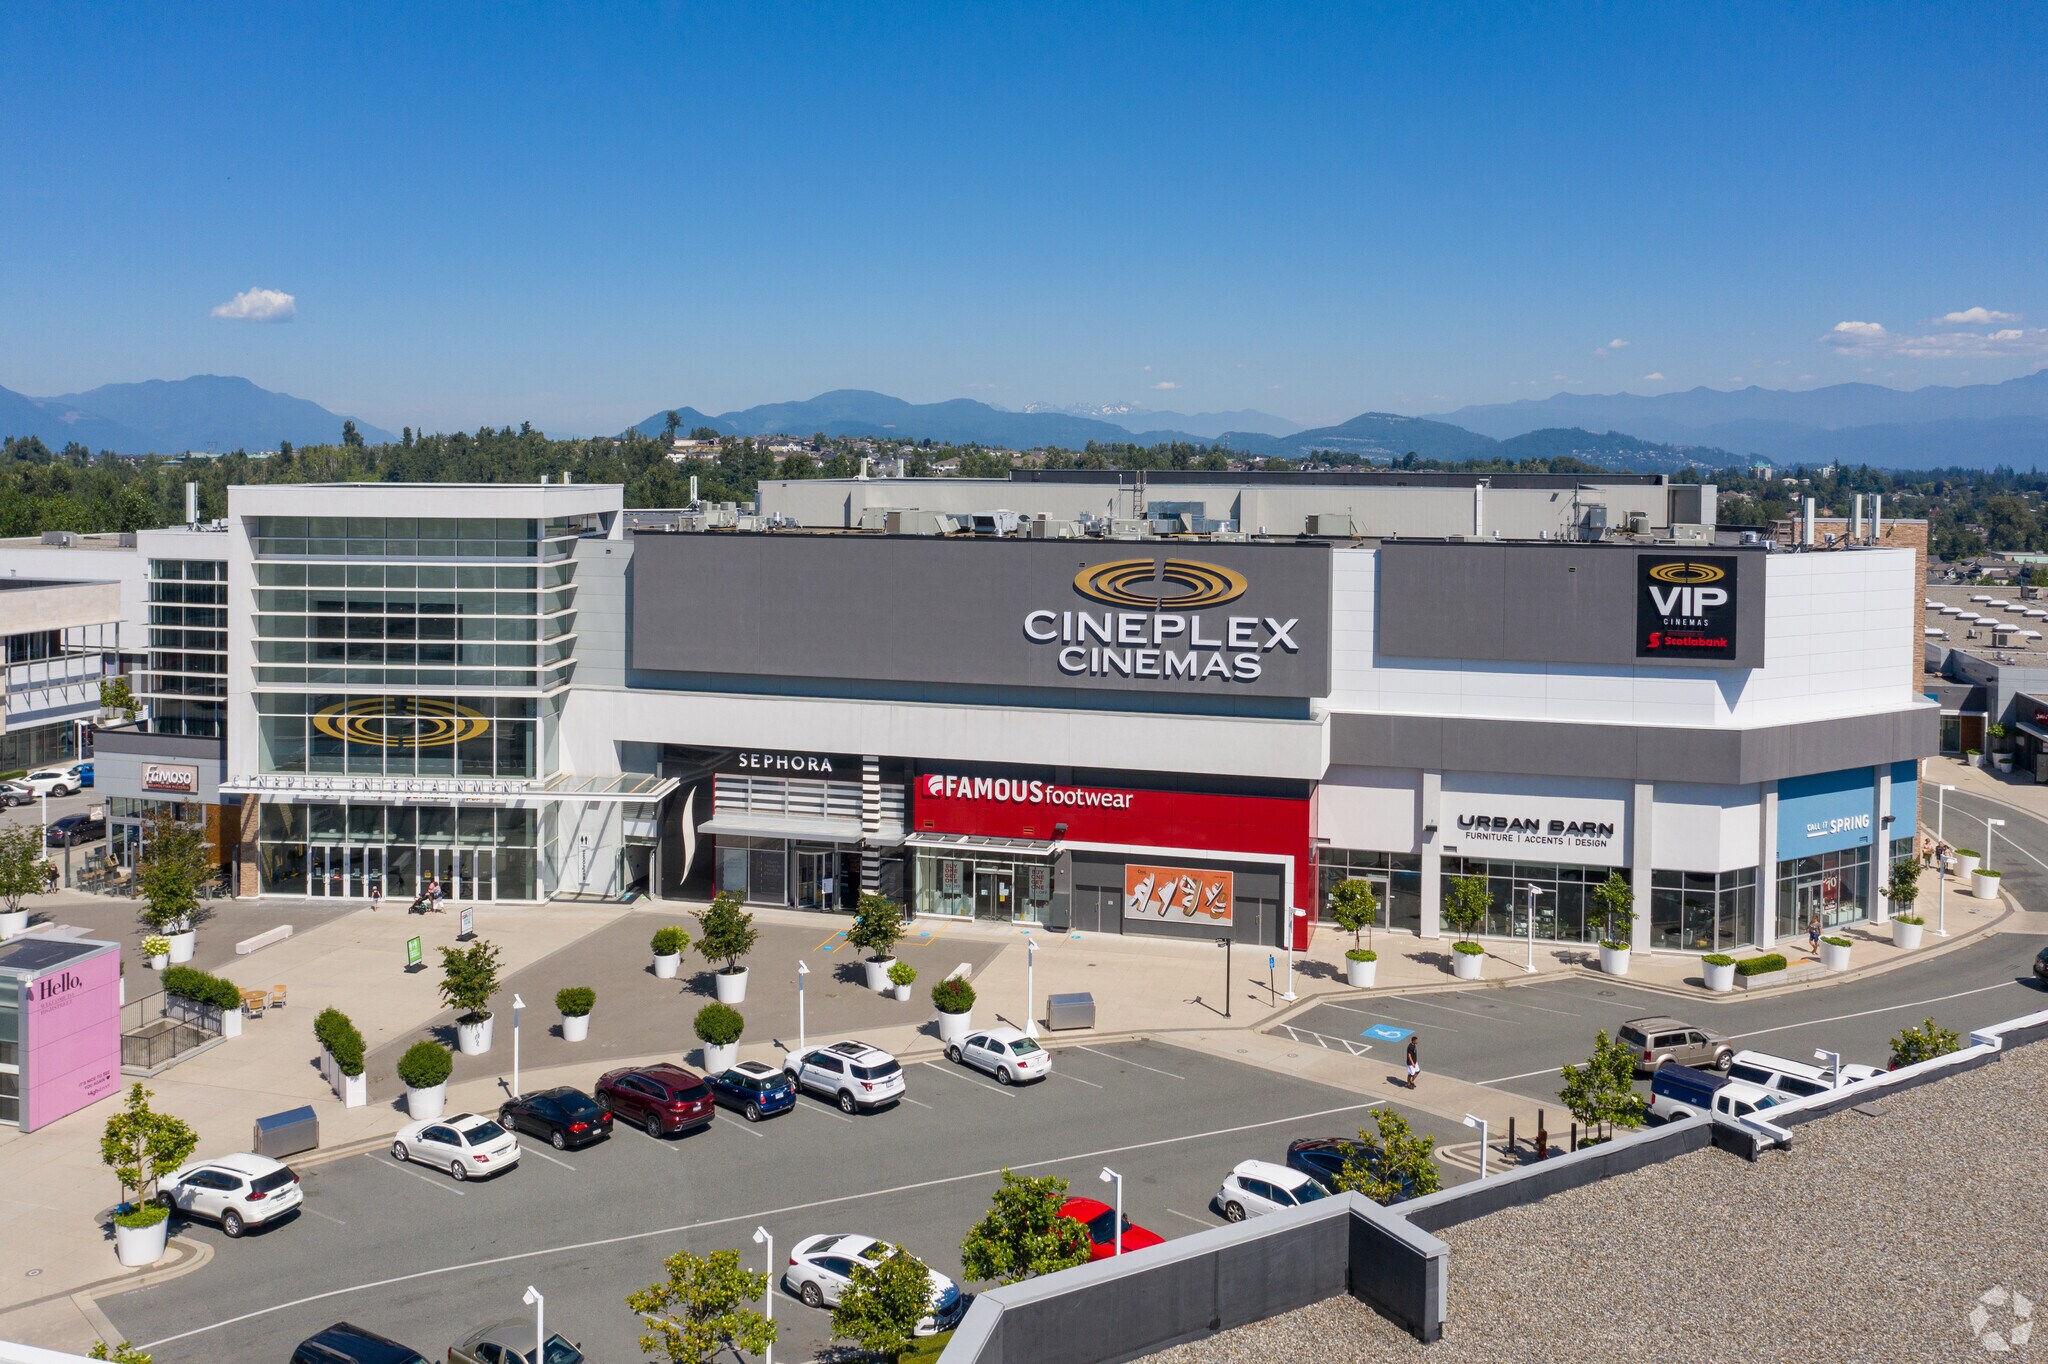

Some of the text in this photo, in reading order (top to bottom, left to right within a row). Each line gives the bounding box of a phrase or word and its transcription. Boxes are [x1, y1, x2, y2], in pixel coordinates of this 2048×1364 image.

[1648, 585, 1728, 617] VIP
[1023, 609, 1299, 651] CINEPLEX
[1663, 618, 1709, 627] CINEMAS
[1664, 636, 1728, 648] Scotiabank
[1057, 646, 1262, 680] CINEMAS
[738, 753, 833, 772] SEPHORA
[231, 774, 525, 796] CINEPLEX ENTERTAINMENT
[944, 775, 1134, 809] FAMOUS footwear
[1458, 814, 1614, 836] URBAN BARN
[1806, 813, 1870, 834] CALL IT SPRING
[1465, 831, 1608, 848] FURNITURE ACCENTS DESIGN
[40, 972, 82, 1001] Hello,
